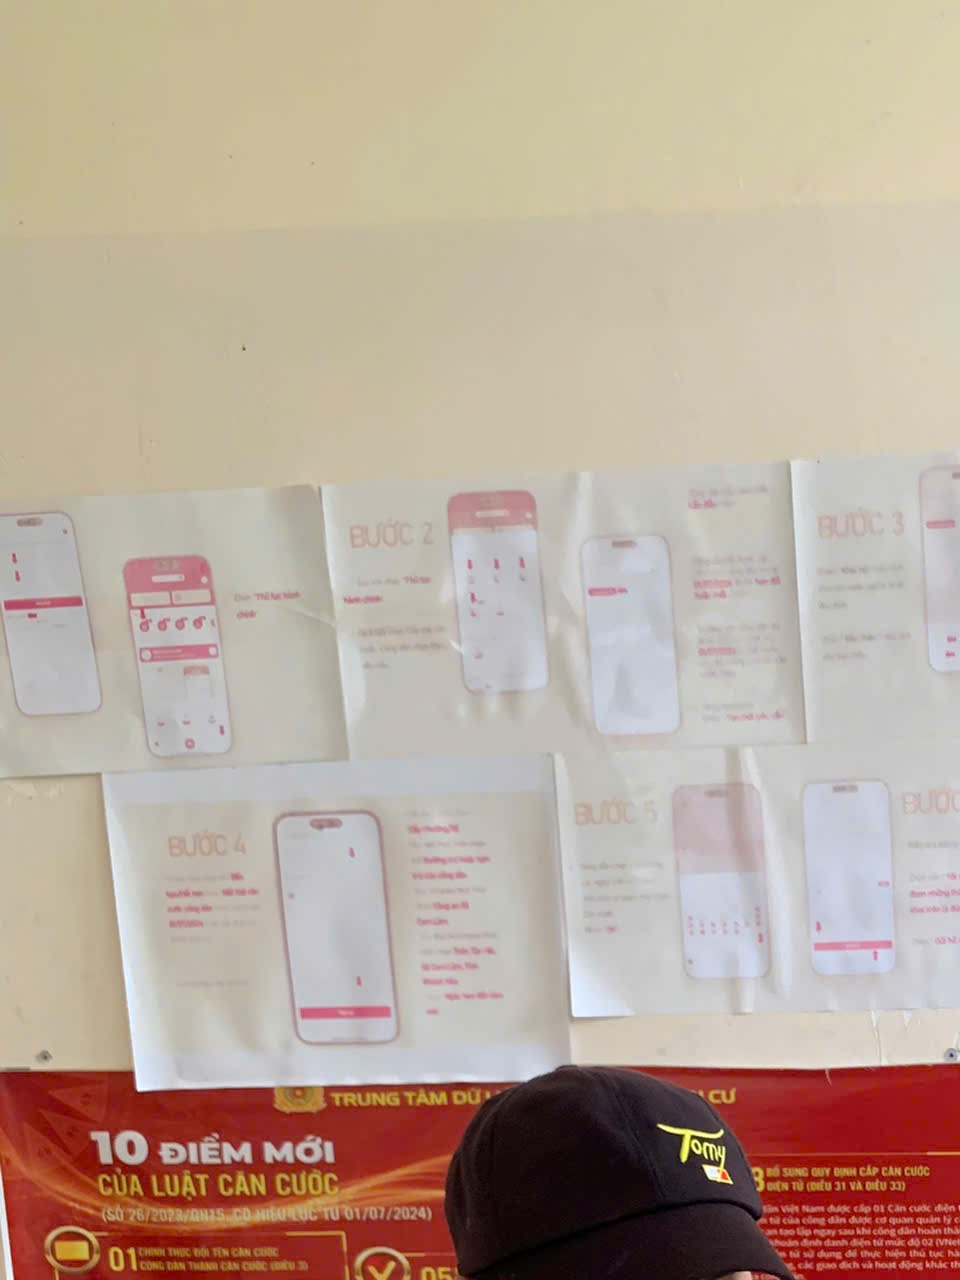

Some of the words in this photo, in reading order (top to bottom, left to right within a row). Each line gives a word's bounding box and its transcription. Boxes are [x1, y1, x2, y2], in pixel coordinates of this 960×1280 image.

[349, 518, 414, 549] BƯỚC
[422, 522, 434, 546] 2
[817, 506, 884, 539] BƯỚC
[891, 510, 905, 537] 3
[573, 797, 638, 827] BƯỚC
[643, 800, 658, 824] 5
[168, 829, 227, 857] BƯỚC
[233, 833, 247, 854] 4
[330, 1091, 401, 1107] TRUNG
[403, 1088, 448, 1106] TÂM
[89, 1130, 149, 1166] 10
[159, 1132, 253, 1165] ĐIỂM
[263, 1135, 335, 1164] MỚI
[656, 1123, 726, 1170] Tomy
[98, 1167, 144, 1197] CỦA
[151, 1170, 209, 1201] LUẬT
[218, 1170, 267, 1196] CĂN
[275, 1168, 339, 1197] CƯỚC
[782, 1167, 808, 1177] SUNG
[811, 1167, 831, 1177] QUY
[834, 1167, 857, 1178] ĐỊNH
[859, 1164, 879, 1176] CẤP
[882, 1166, 902, 1176] CĂN
[904, 1165, 930, 1176] CƯỚC
[807, 1179, 831, 1192] (ĐIỀU
[834, 1181, 845, 1191] 31
[850, 1179, 862, 1191] VÀ
[866, 1179, 886, 1191] ĐIỀU
[890, 1181, 906, 1192] 33)
[344, 1206, 432, 1222] 01/07/2024)
[873, 1205, 885, 1213] 01
[108, 1246, 138, 1272] 01
